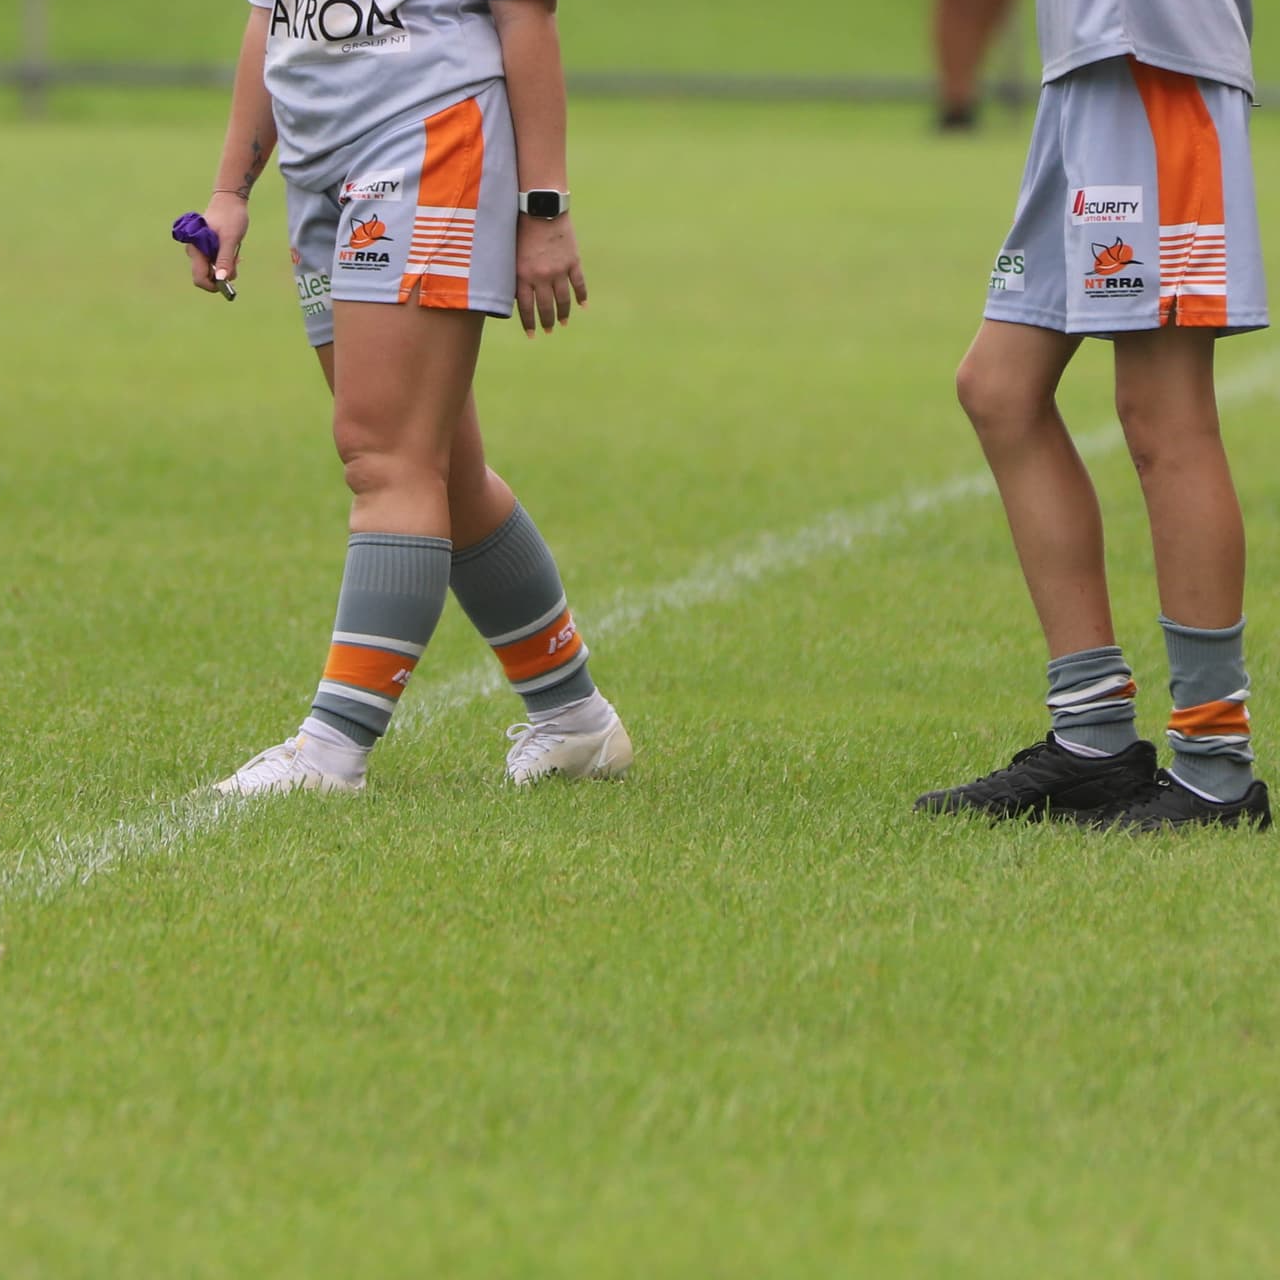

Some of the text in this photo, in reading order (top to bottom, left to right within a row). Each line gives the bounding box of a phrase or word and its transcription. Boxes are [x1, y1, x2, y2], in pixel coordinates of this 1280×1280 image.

[341, 34, 408, 54] GROUP NT
[338, 250, 390, 263] NTRRA
[993, 255, 1025, 274] es
[1083, 277, 1144, 289] NTRRA
